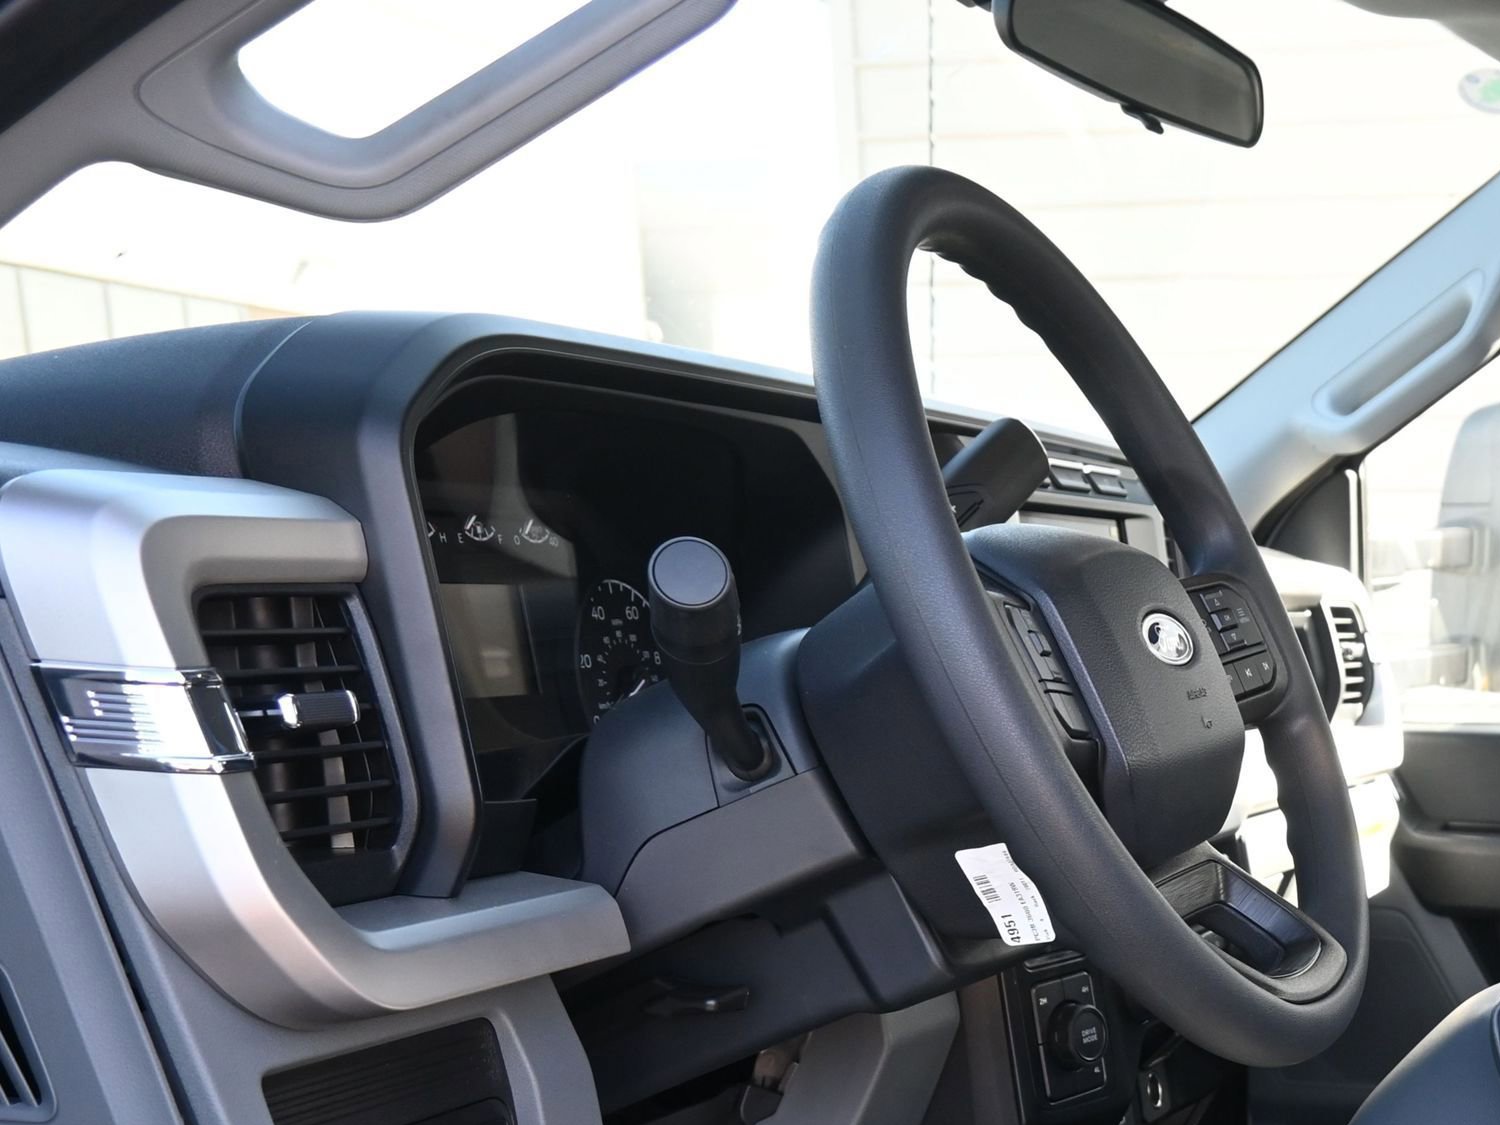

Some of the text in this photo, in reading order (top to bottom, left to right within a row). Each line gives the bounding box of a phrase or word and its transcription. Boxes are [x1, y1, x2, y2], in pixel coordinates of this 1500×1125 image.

[457, 532, 463, 543] E
[497, 534, 503, 544] F
[591, 606, 605, 620] 40
[626, 606, 639, 620] 60
[1001, 914, 1021, 943] 4951
[1083, 1034, 1098, 1044] MODE
